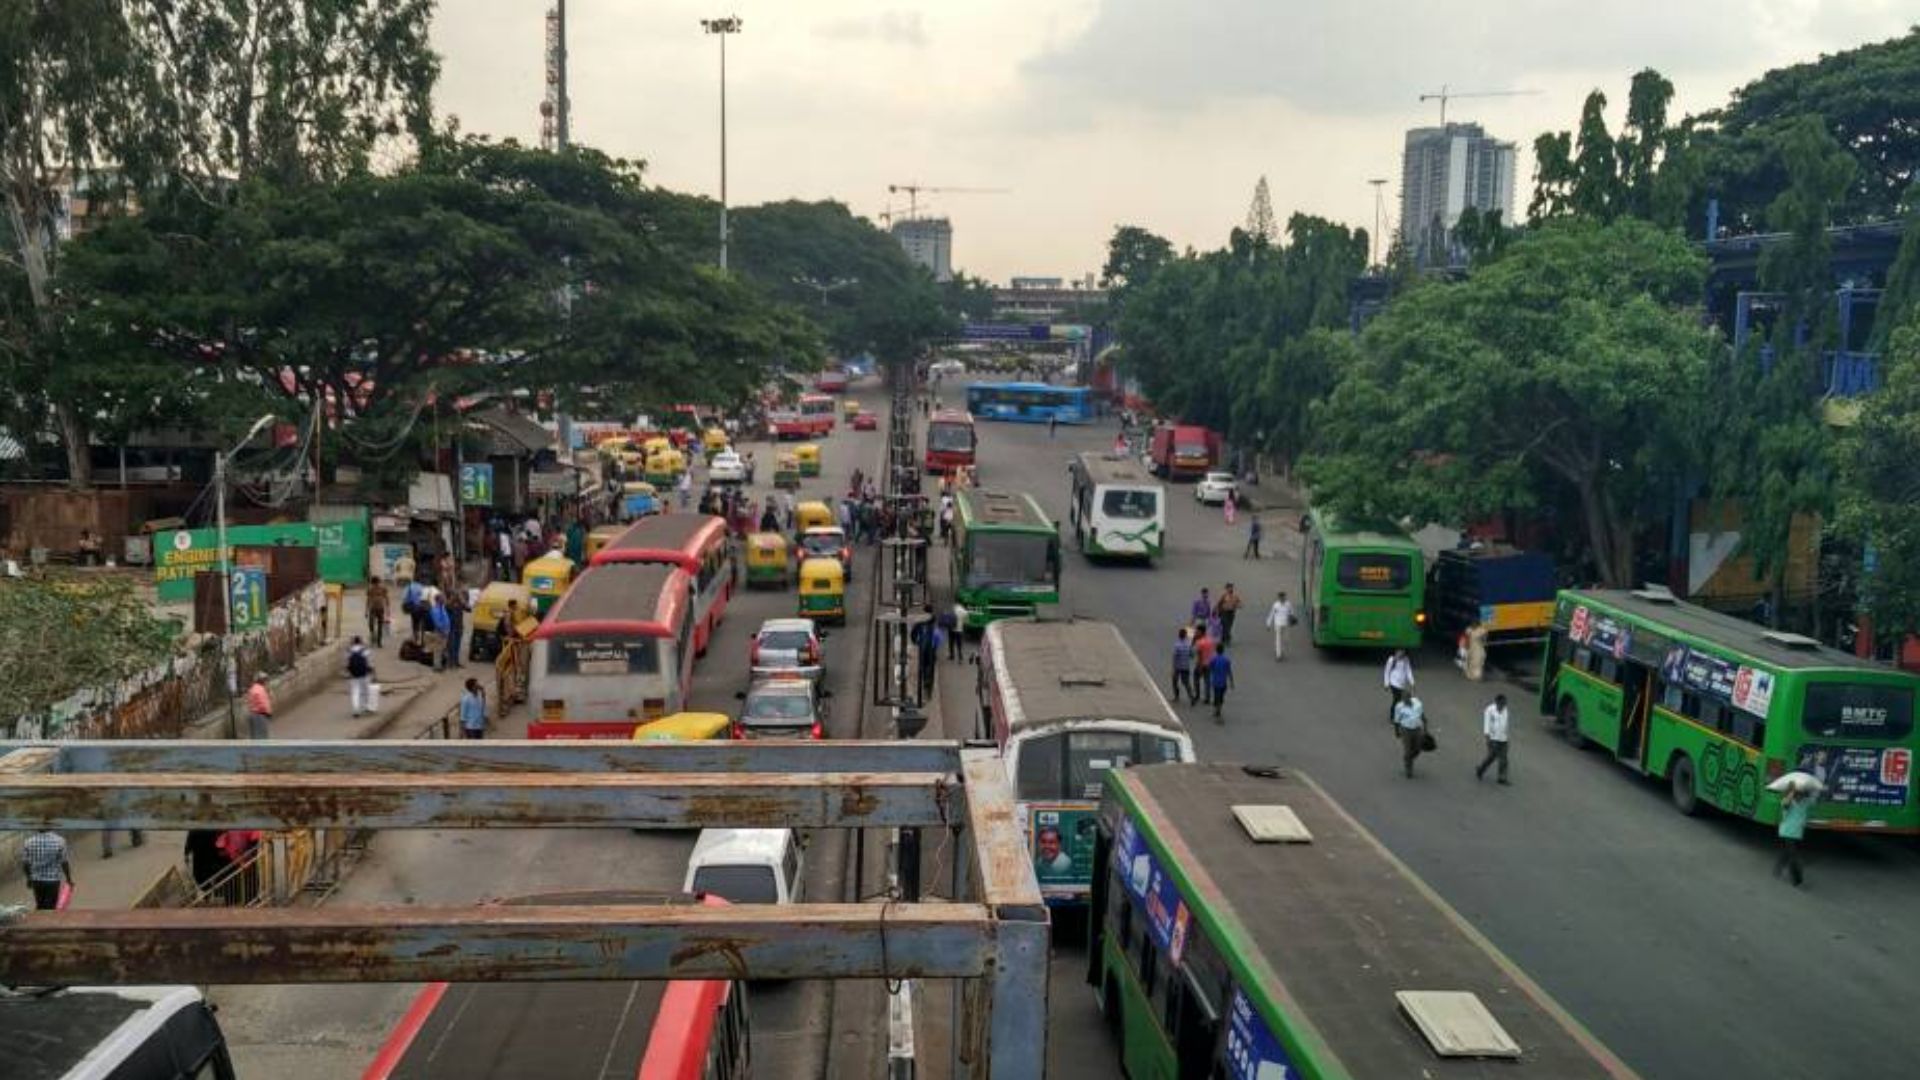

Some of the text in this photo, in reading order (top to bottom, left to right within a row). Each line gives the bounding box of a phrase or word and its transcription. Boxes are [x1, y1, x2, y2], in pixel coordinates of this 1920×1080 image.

[463, 465, 476, 481] 2
[233, 572, 247, 595] 2
[234, 601, 248, 624] 3
